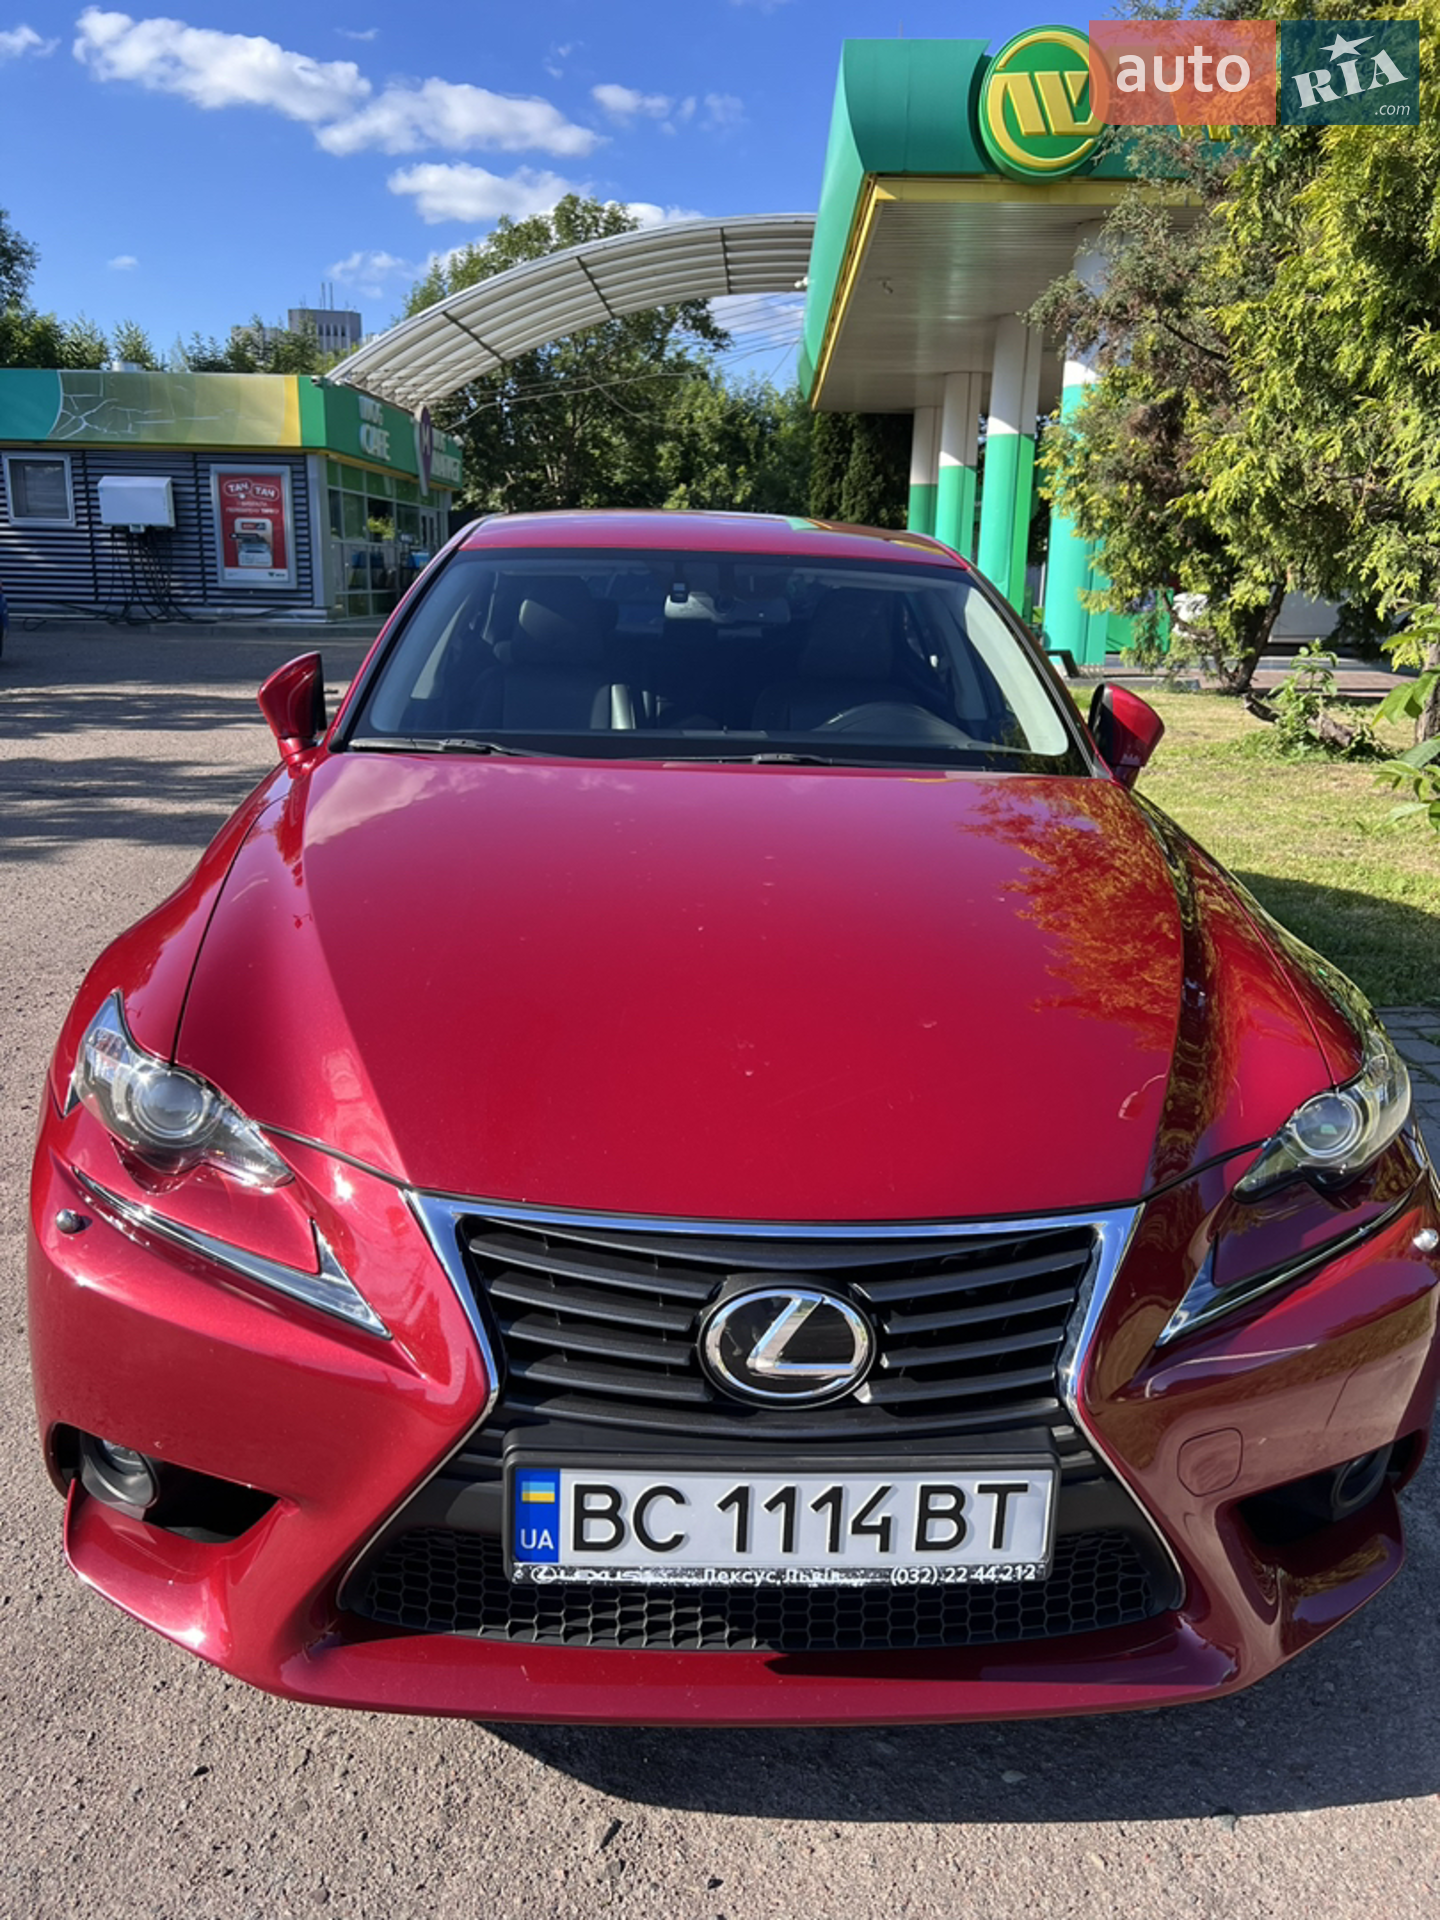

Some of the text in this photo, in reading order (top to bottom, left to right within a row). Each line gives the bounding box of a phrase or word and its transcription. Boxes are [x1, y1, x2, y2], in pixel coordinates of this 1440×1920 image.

[571, 1483, 1029, 1553] BC 1114 BT
[521, 1529, 554, 1550] UA
[890, 1566, 938, 1585] (032)
